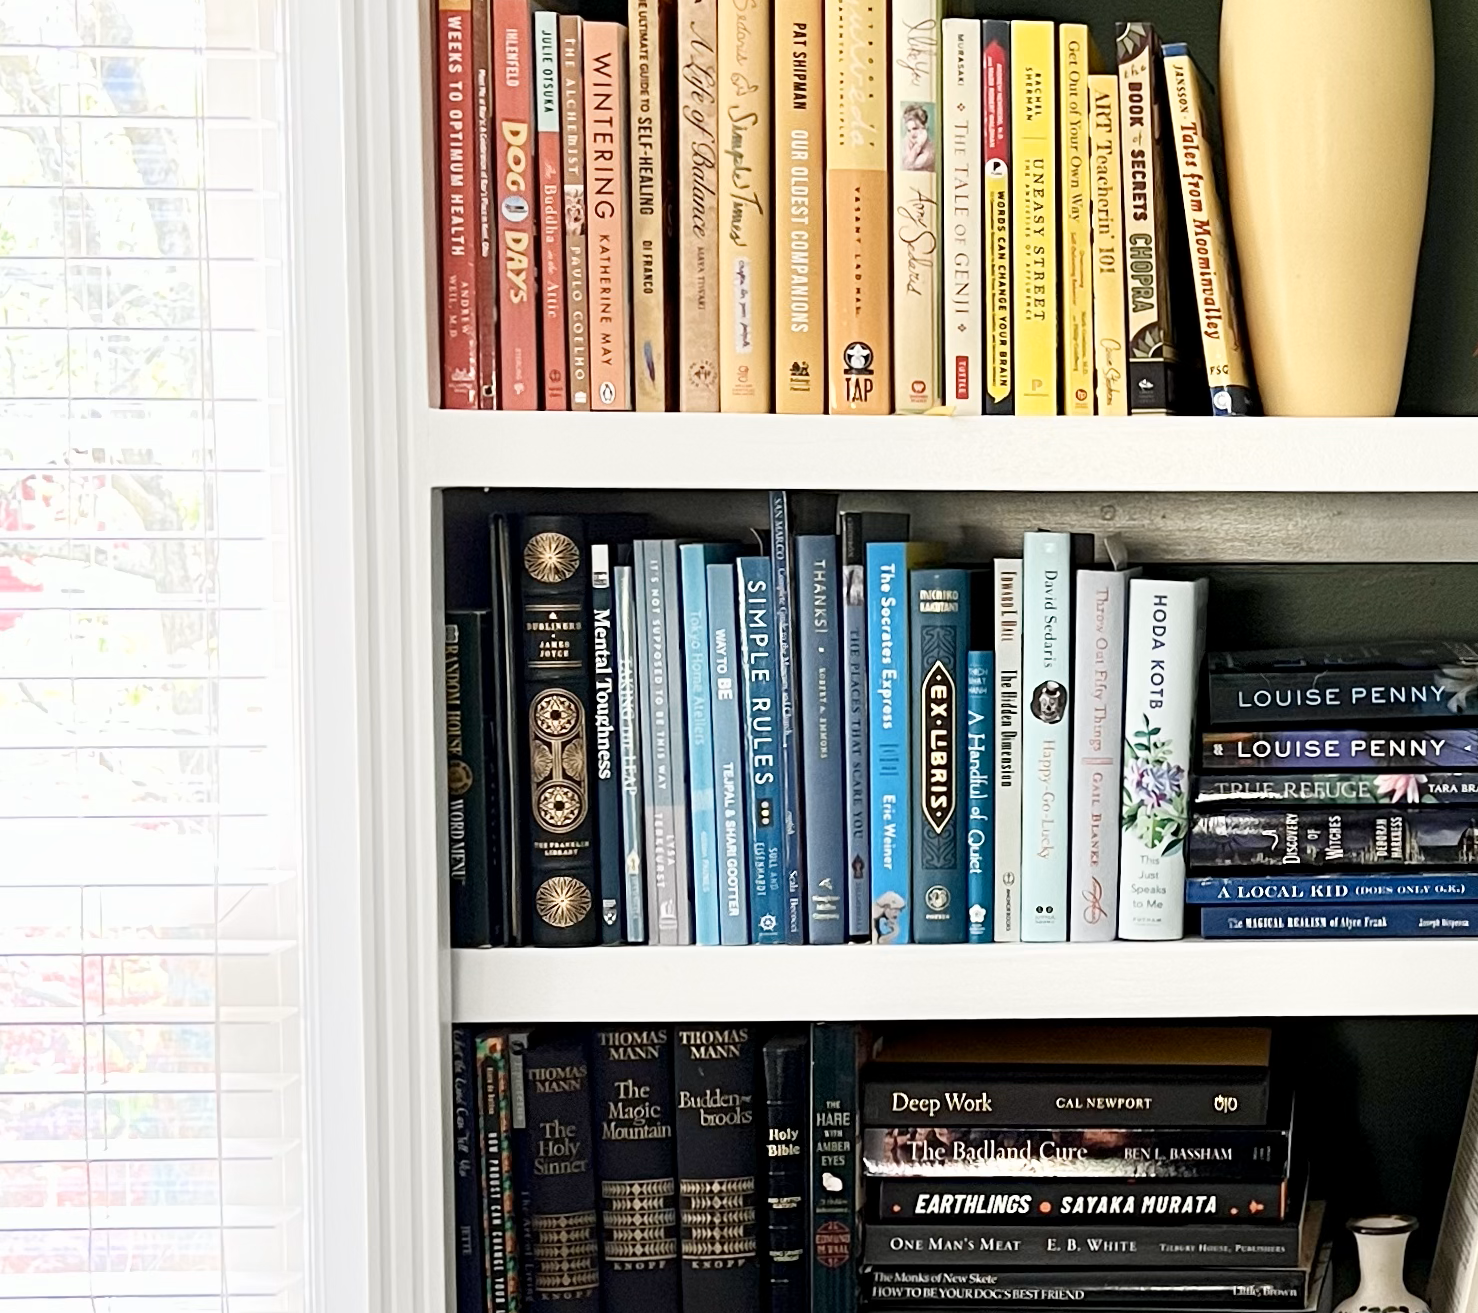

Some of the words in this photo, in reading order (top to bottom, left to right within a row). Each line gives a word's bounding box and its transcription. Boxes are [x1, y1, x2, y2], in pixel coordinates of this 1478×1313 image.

[448, 15, 463, 73] WEEKS
[449, 81, 463, 107] TO
[449, 110, 464, 188] OPTIMUM
[592, 53, 615, 220] WINTERING
[792, 130, 809, 163] OUR
[792, 167, 809, 231] OLDEST
[997, 191, 1005, 232] WORDS
[1033, 159, 1045, 241] UNEASY
[451, 195, 465, 257] HEALTH
[998, 237, 1006, 260] CAN
[792, 231, 809, 333] COMPANIONS
[998, 264, 1006, 311] CHANGE
[1033, 246, 1045, 321] STREET
[999, 317, 1007, 346] YOUR
[999, 351, 1008, 386] BRAIN
[880, 563, 895, 591] The
[1043, 570, 1058, 612] David
[593, 609, 610, 675] Mental
[747, 580, 769, 681] SIMPLE
[879, 596, 896, 664] Socrates
[1043, 616, 1057, 668] Sedaris
[1152, 595, 1168, 650] HODA
[877, 669, 897, 730] Express
[1150, 660, 1165, 709] KOTB
[1238, 688, 1341, 707] LOUISE
[1352, 686, 1446, 705] PENNY
[594, 677, 613, 780] Toughness
[752, 698, 773, 784] RULES
[1237, 740, 1340, 758] LOUISE
[1350, 740, 1446, 758] PENNY
[883, 795, 896, 826] Eric
[883, 825, 896, 870] Weiner
[614, 1079, 650, 1098] The
[892, 1092, 940, 1117] Deep
[945, 1092, 992, 1113] Work
[1056, 1097, 1083, 1110] CAL
[1085, 1097, 1152, 1110] NEWPORT
[602, 1122, 671, 1140] Mountain
[608, 1101, 661, 1126] Magic
[915, 1195, 1031, 1214] EARTHLINGS
[1061, 1196, 1135, 1214] SAYAKA
[1142, 1196, 1217, 1214] MURATA
